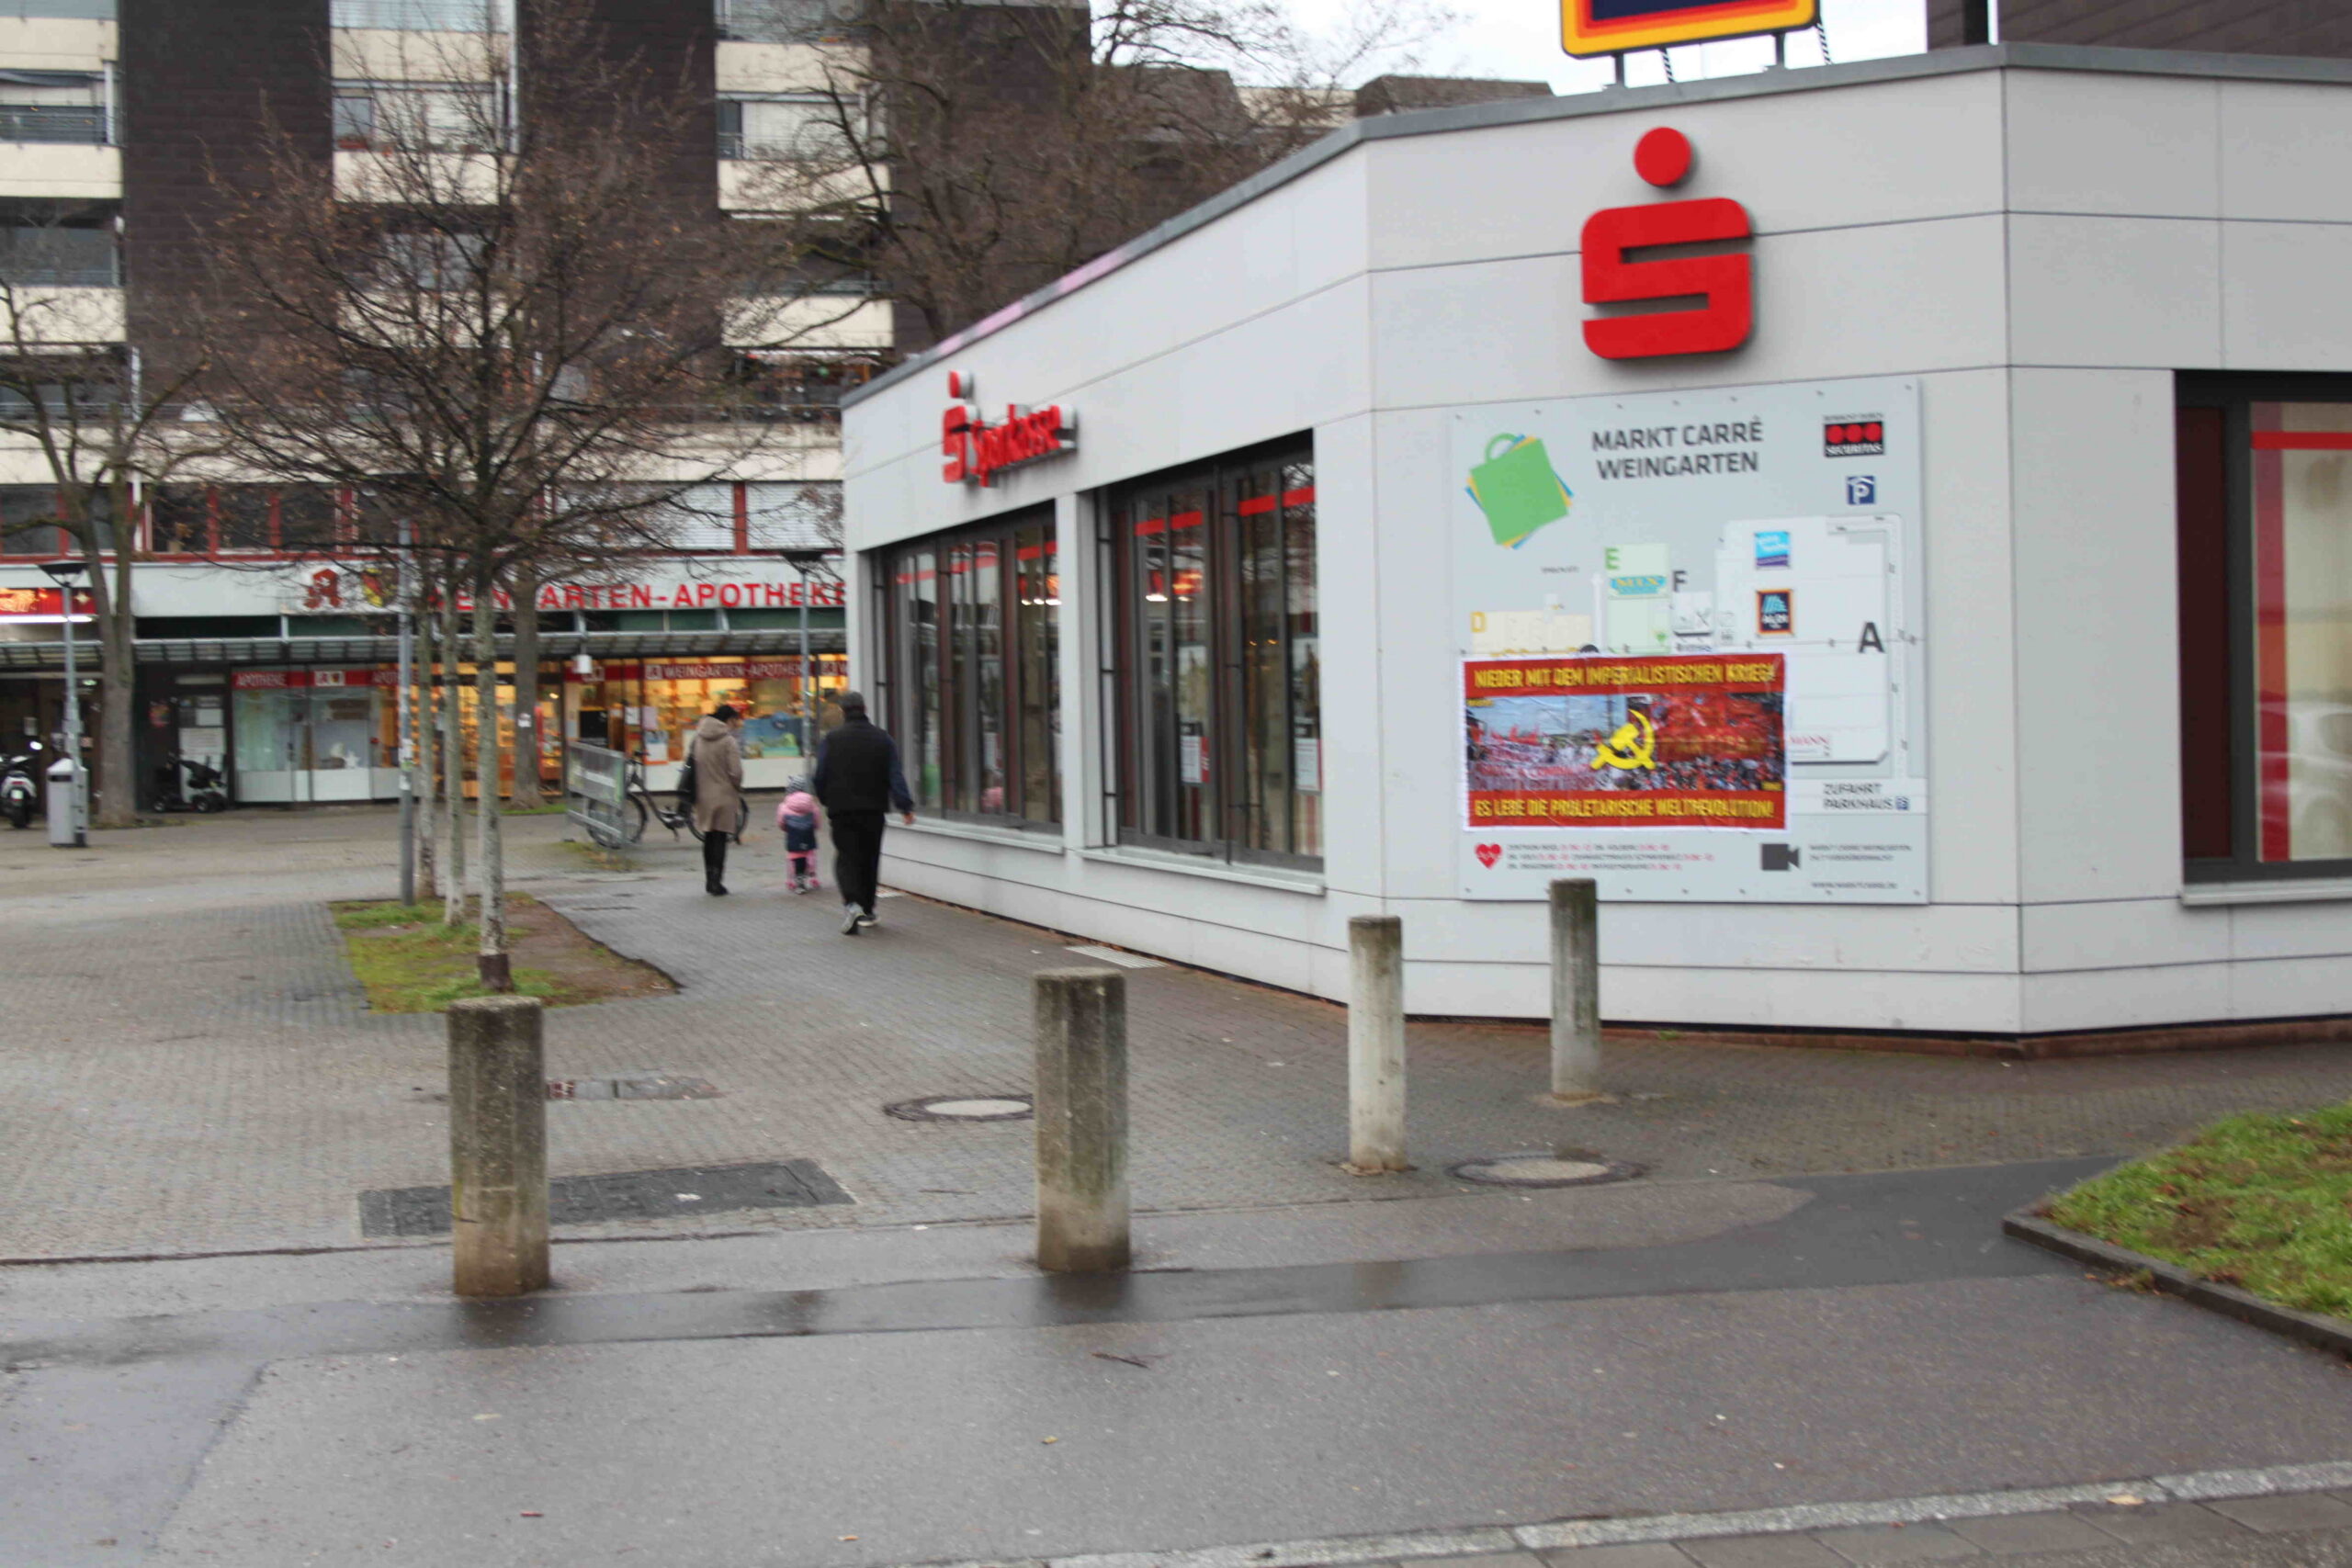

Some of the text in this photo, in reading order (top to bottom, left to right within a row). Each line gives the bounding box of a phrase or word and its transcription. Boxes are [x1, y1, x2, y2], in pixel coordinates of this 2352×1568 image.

[1592, 415, 1764, 452] MARKT CARRÉ
[1597, 450, 1759, 480] WEINGARTEN
[1605, 547, 1621, 570] E
[1673, 570, 1688, 592] F
[1858, 622, 1886, 654] A
[1474, 669, 1524, 688] NIEDER
[1525, 668, 1552, 687] MIT
[1554, 667, 1584, 686] DEM
[1586, 663, 1724, 685] IMPERIALISTISCHEN
[1823, 783, 1882, 795] ZUFAHRT
[1475, 798, 1775, 818] ES LEBE DIE PROLETARISCHE WELTREVOLUTION!
[1823, 797, 1893, 810] PARKHAUS
